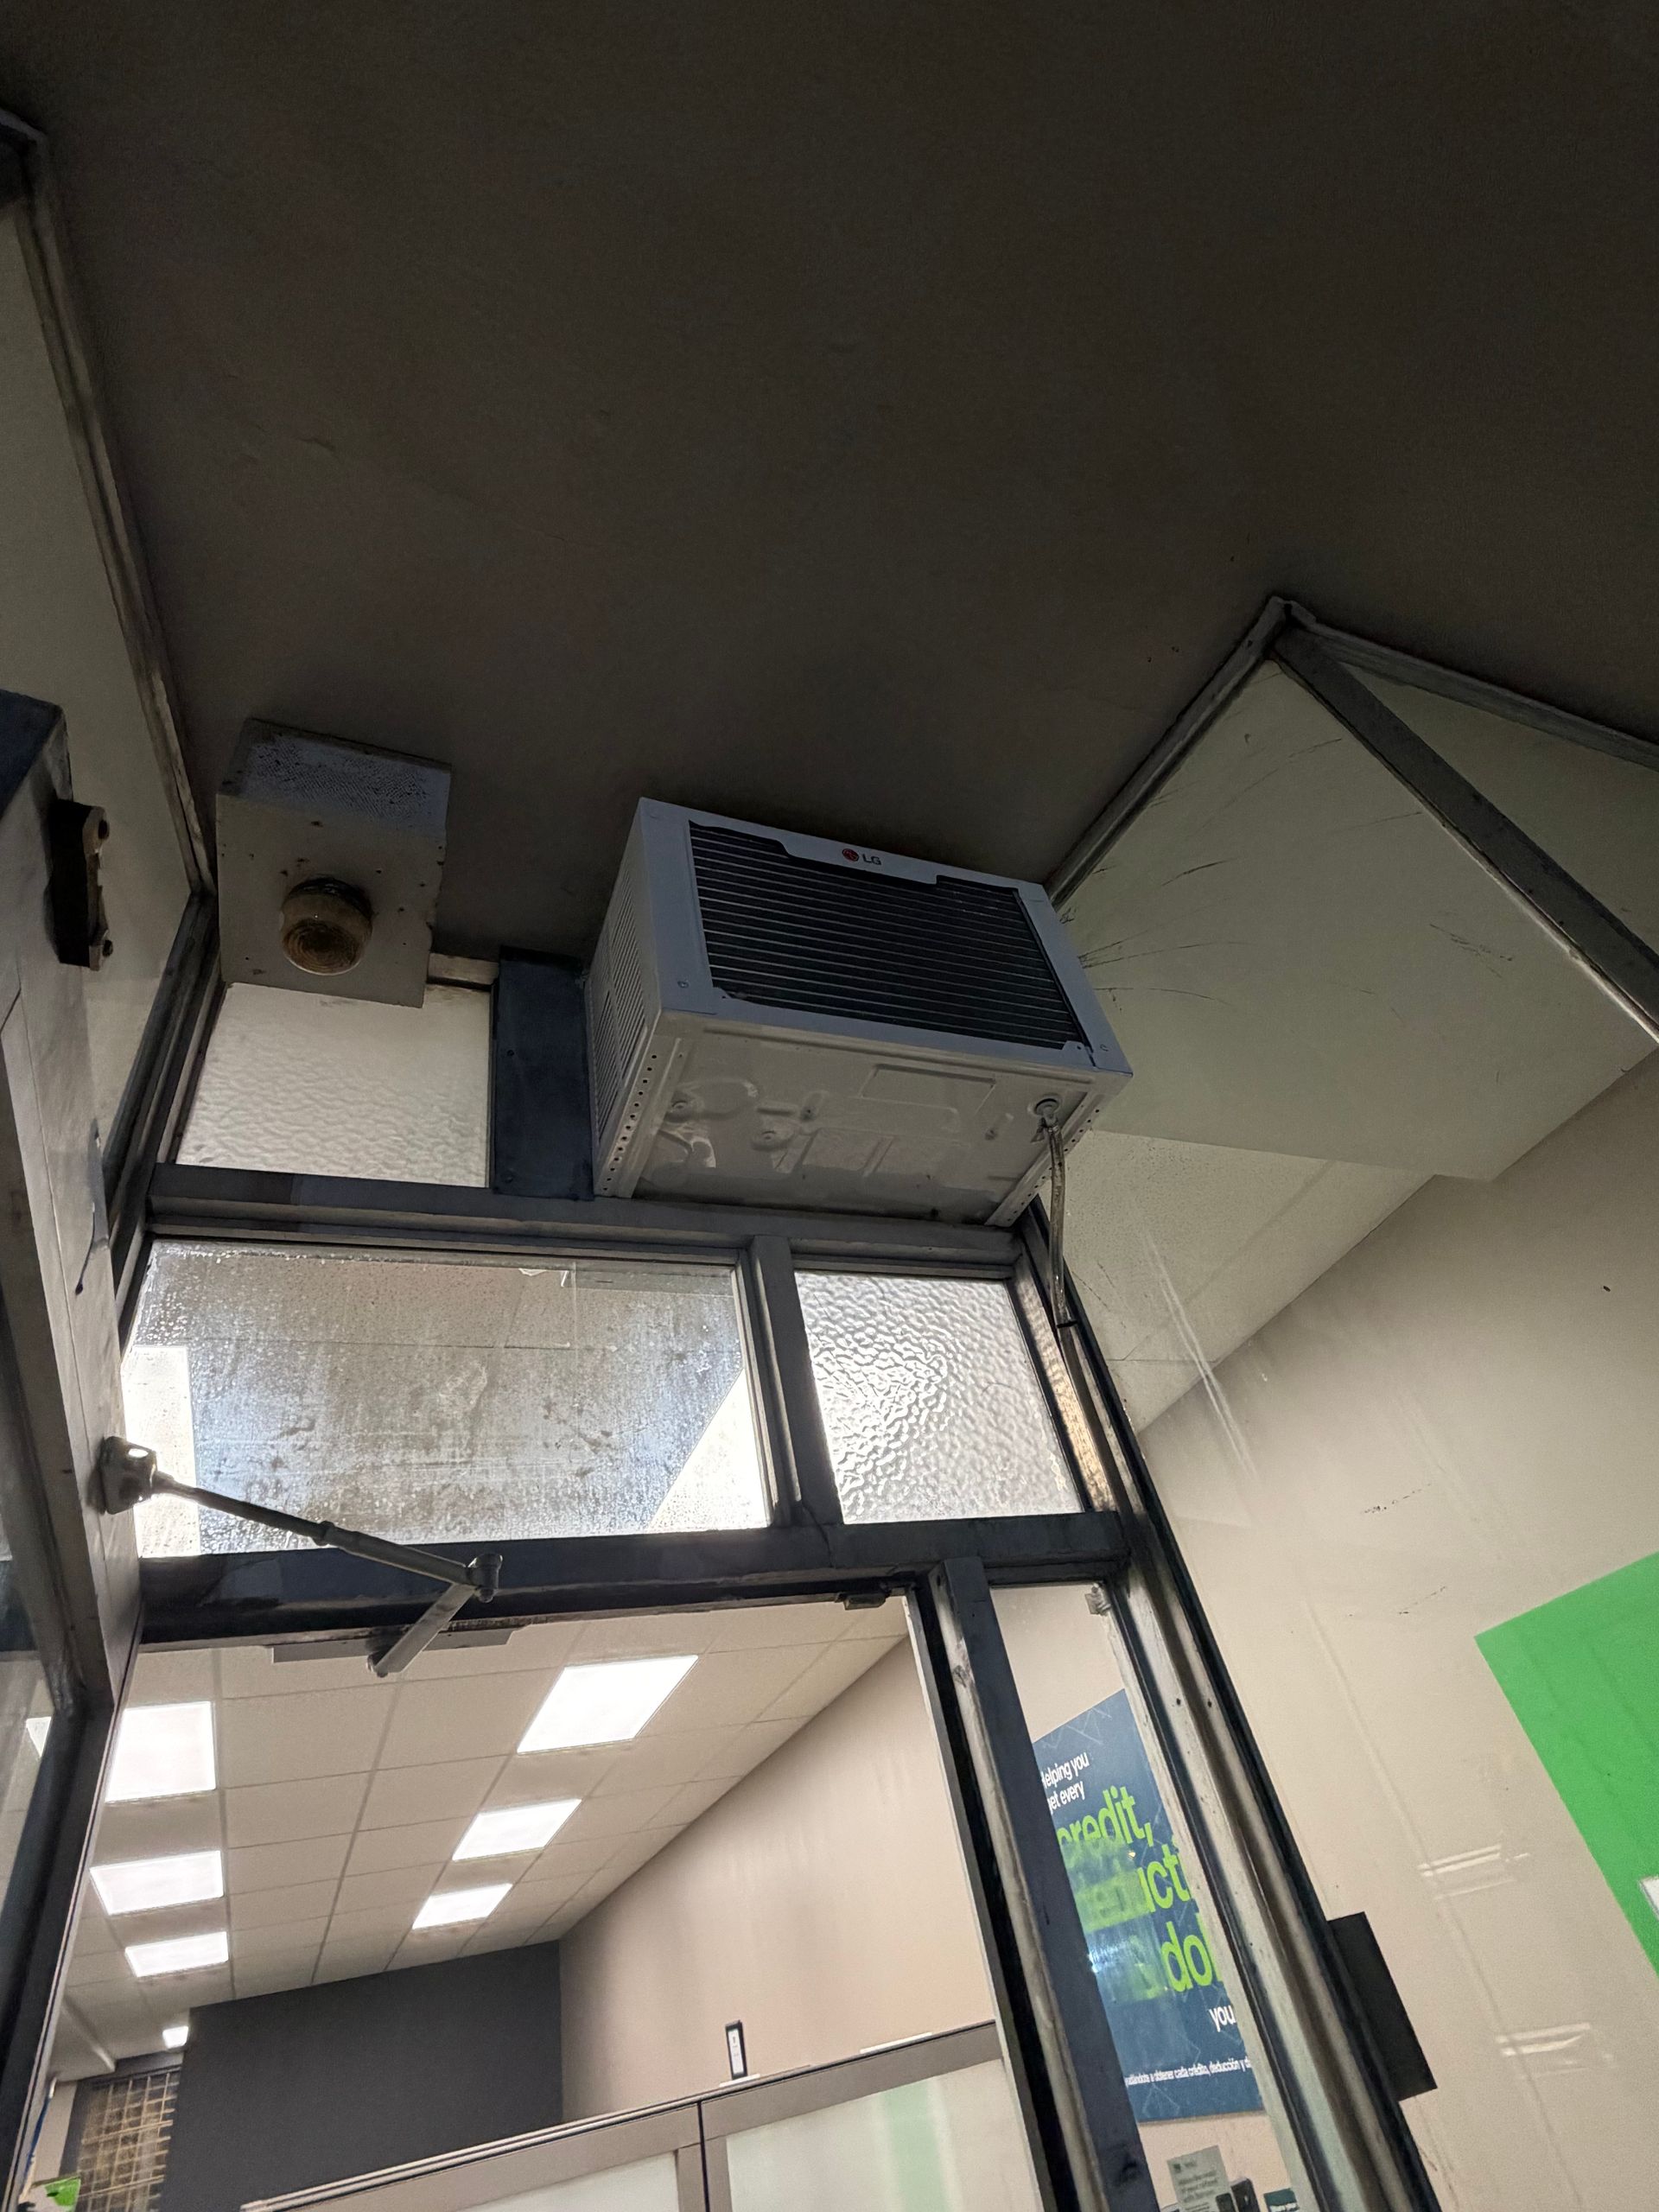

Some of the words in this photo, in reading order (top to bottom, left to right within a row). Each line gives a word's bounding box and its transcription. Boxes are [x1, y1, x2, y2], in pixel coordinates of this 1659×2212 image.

[862, 854, 881, 866] LG
[1070, 1751, 1090, 1777] you
[1059, 1781, 1085, 1801] every
[1057, 1785, 1154, 1866] credit,
[1209, 2005, 1236, 2032] you
